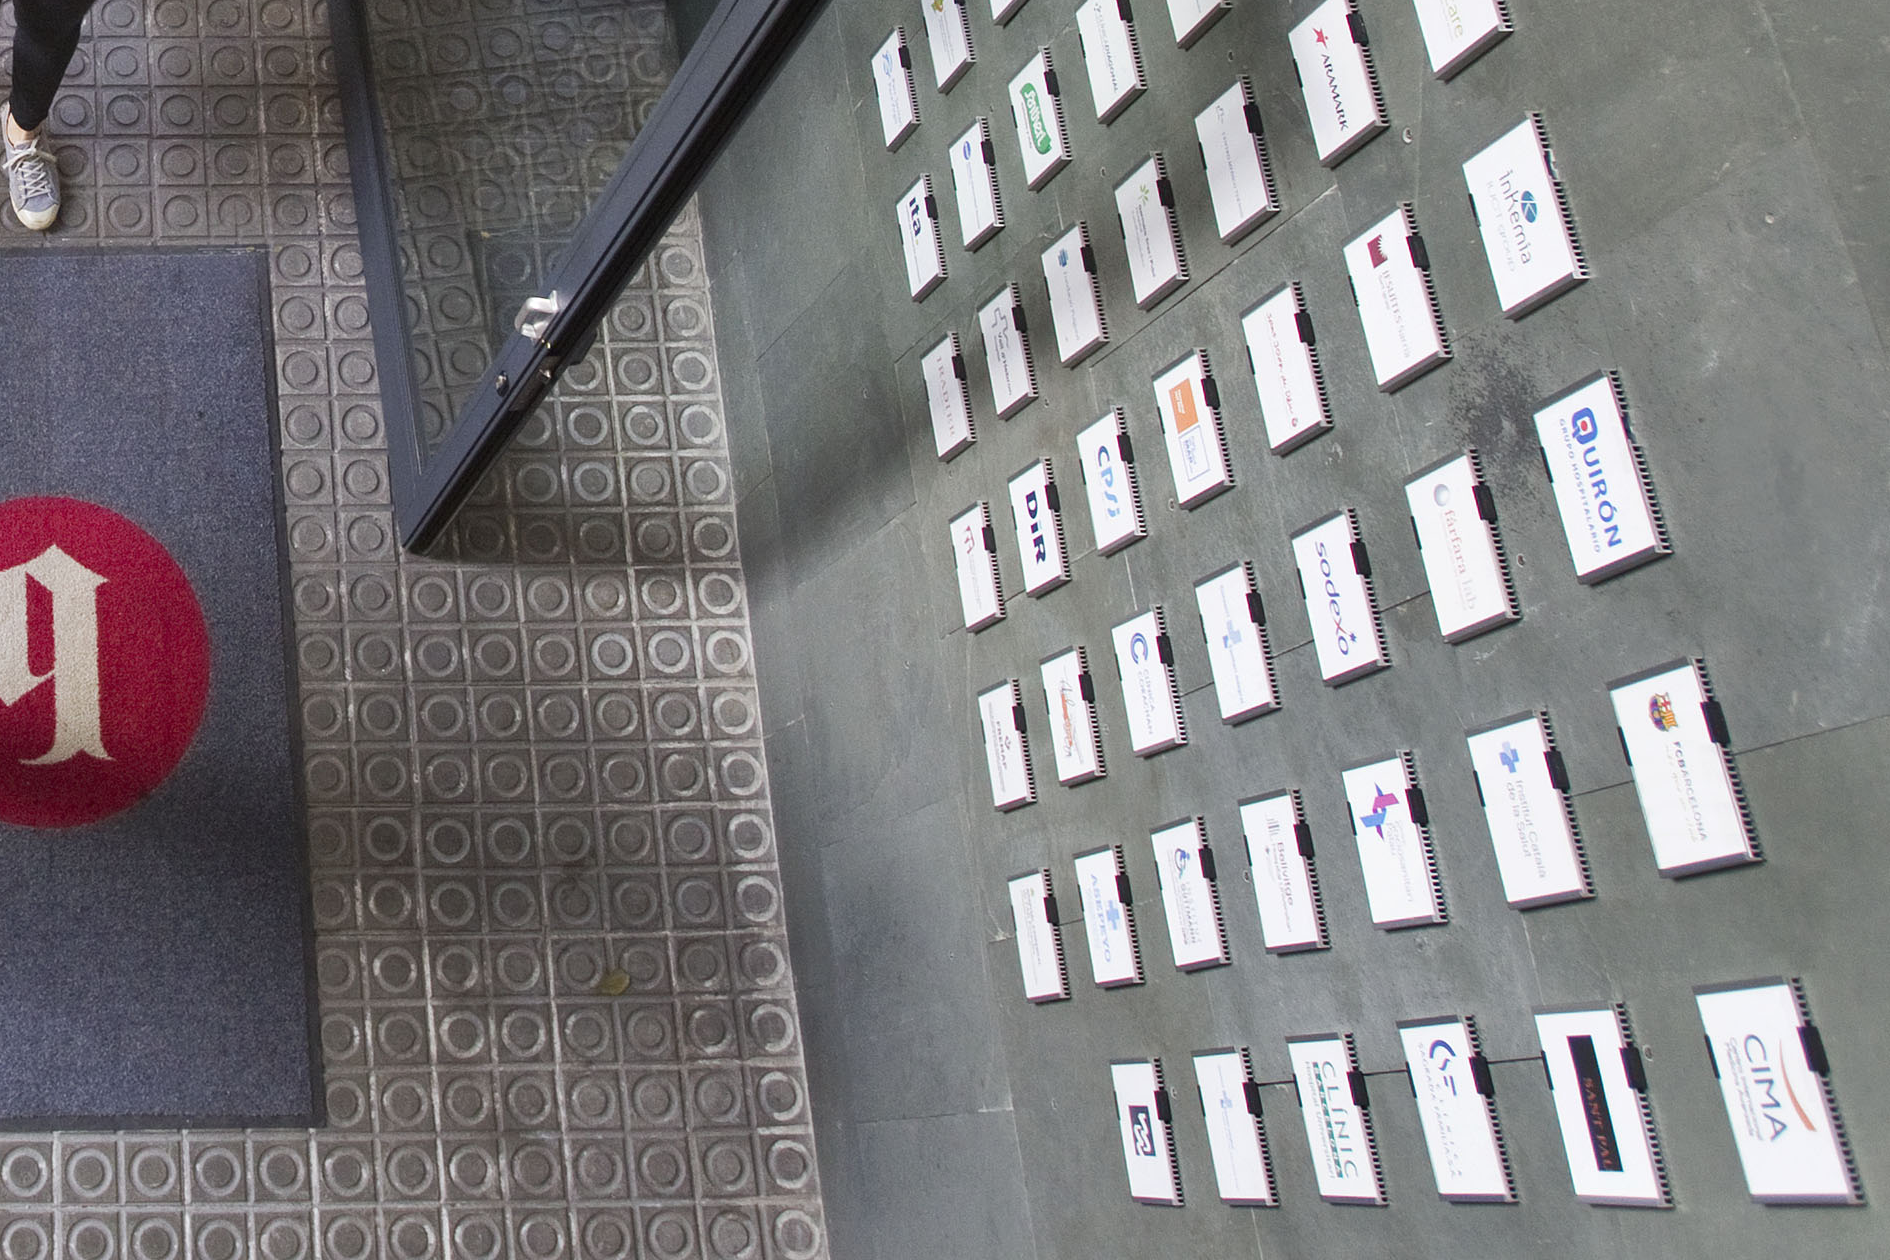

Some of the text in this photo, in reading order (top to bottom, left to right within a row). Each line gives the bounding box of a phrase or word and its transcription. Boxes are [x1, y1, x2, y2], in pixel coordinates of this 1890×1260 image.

[1321, 54, 1348, 131] ARAMARK
[1559, 418, 1601, 553] GRUPO HOSPITALARIO
[1571, 407, 1622, 548] QUIRÓN
[1317, 542, 1351, 656] sodexo
[996, 720, 1007, 770] FREMAP
[1506, 781, 1532, 858] de la Salut
[1515, 779, 1534, 827] Institut
[1277, 841, 1294, 906] Bellvitge
[1090, 873, 1111, 963] ASEPEYO
[1321, 1060, 1358, 1178] CLÍNIC
[1581, 1076, 1604, 1130] SANT
[1743, 1034, 1788, 1141] CIMA
